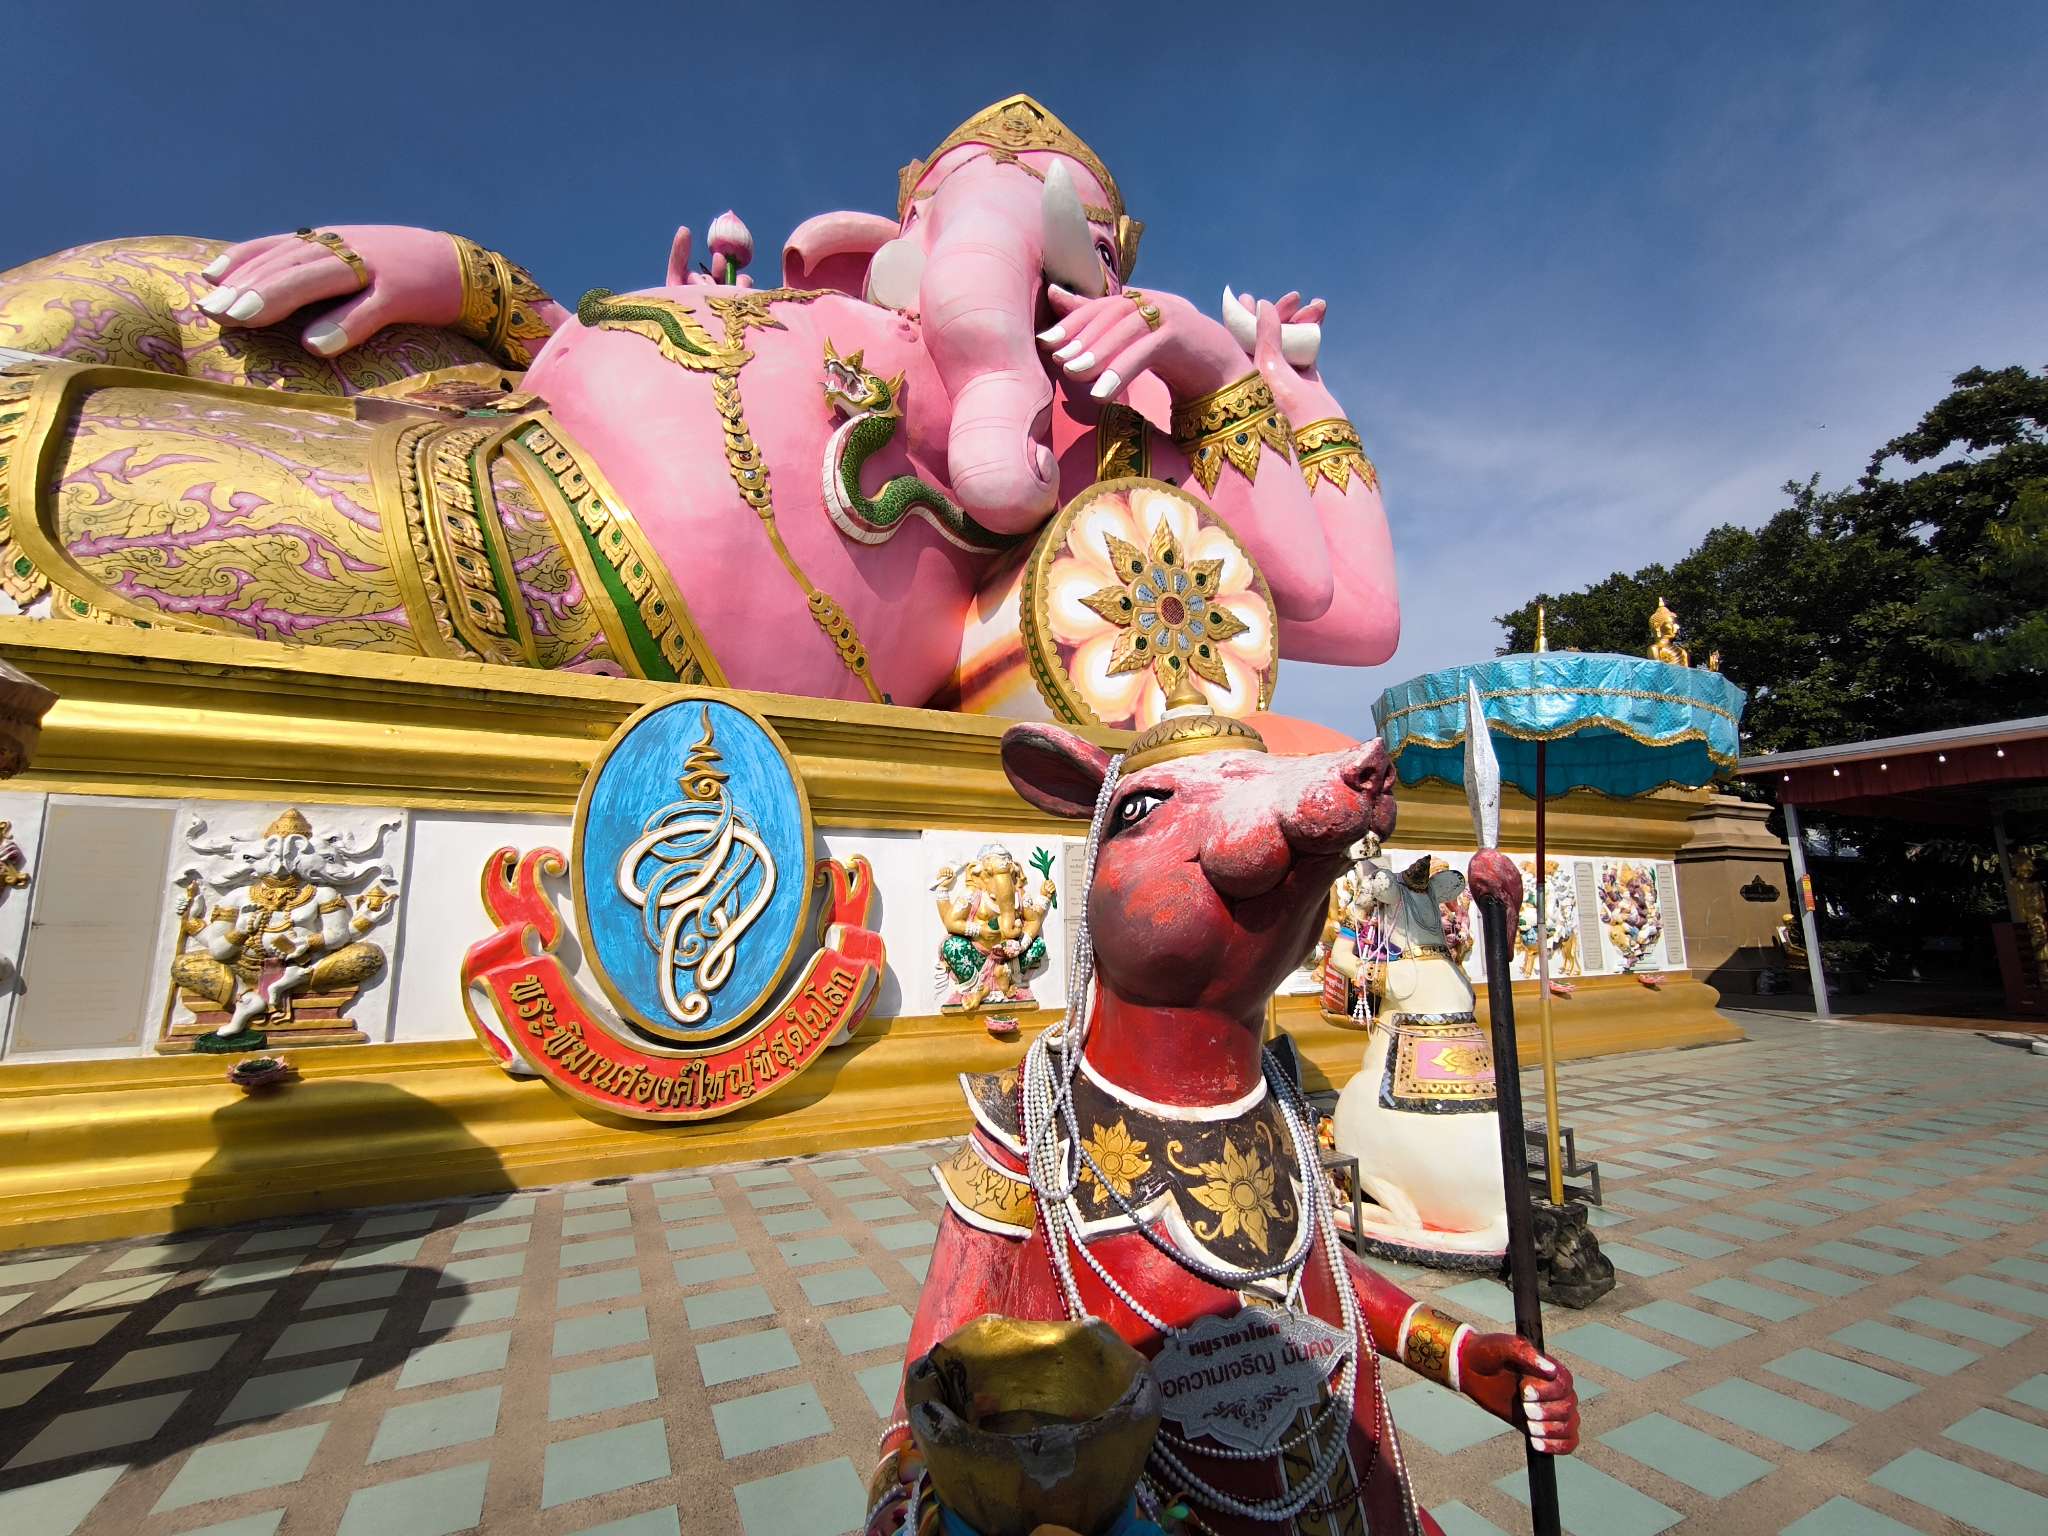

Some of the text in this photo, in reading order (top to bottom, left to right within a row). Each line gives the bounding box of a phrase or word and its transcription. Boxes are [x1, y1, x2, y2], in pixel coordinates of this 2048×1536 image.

[1157, 1336, 1335, 1399] อความเจริญ มั่นคง
